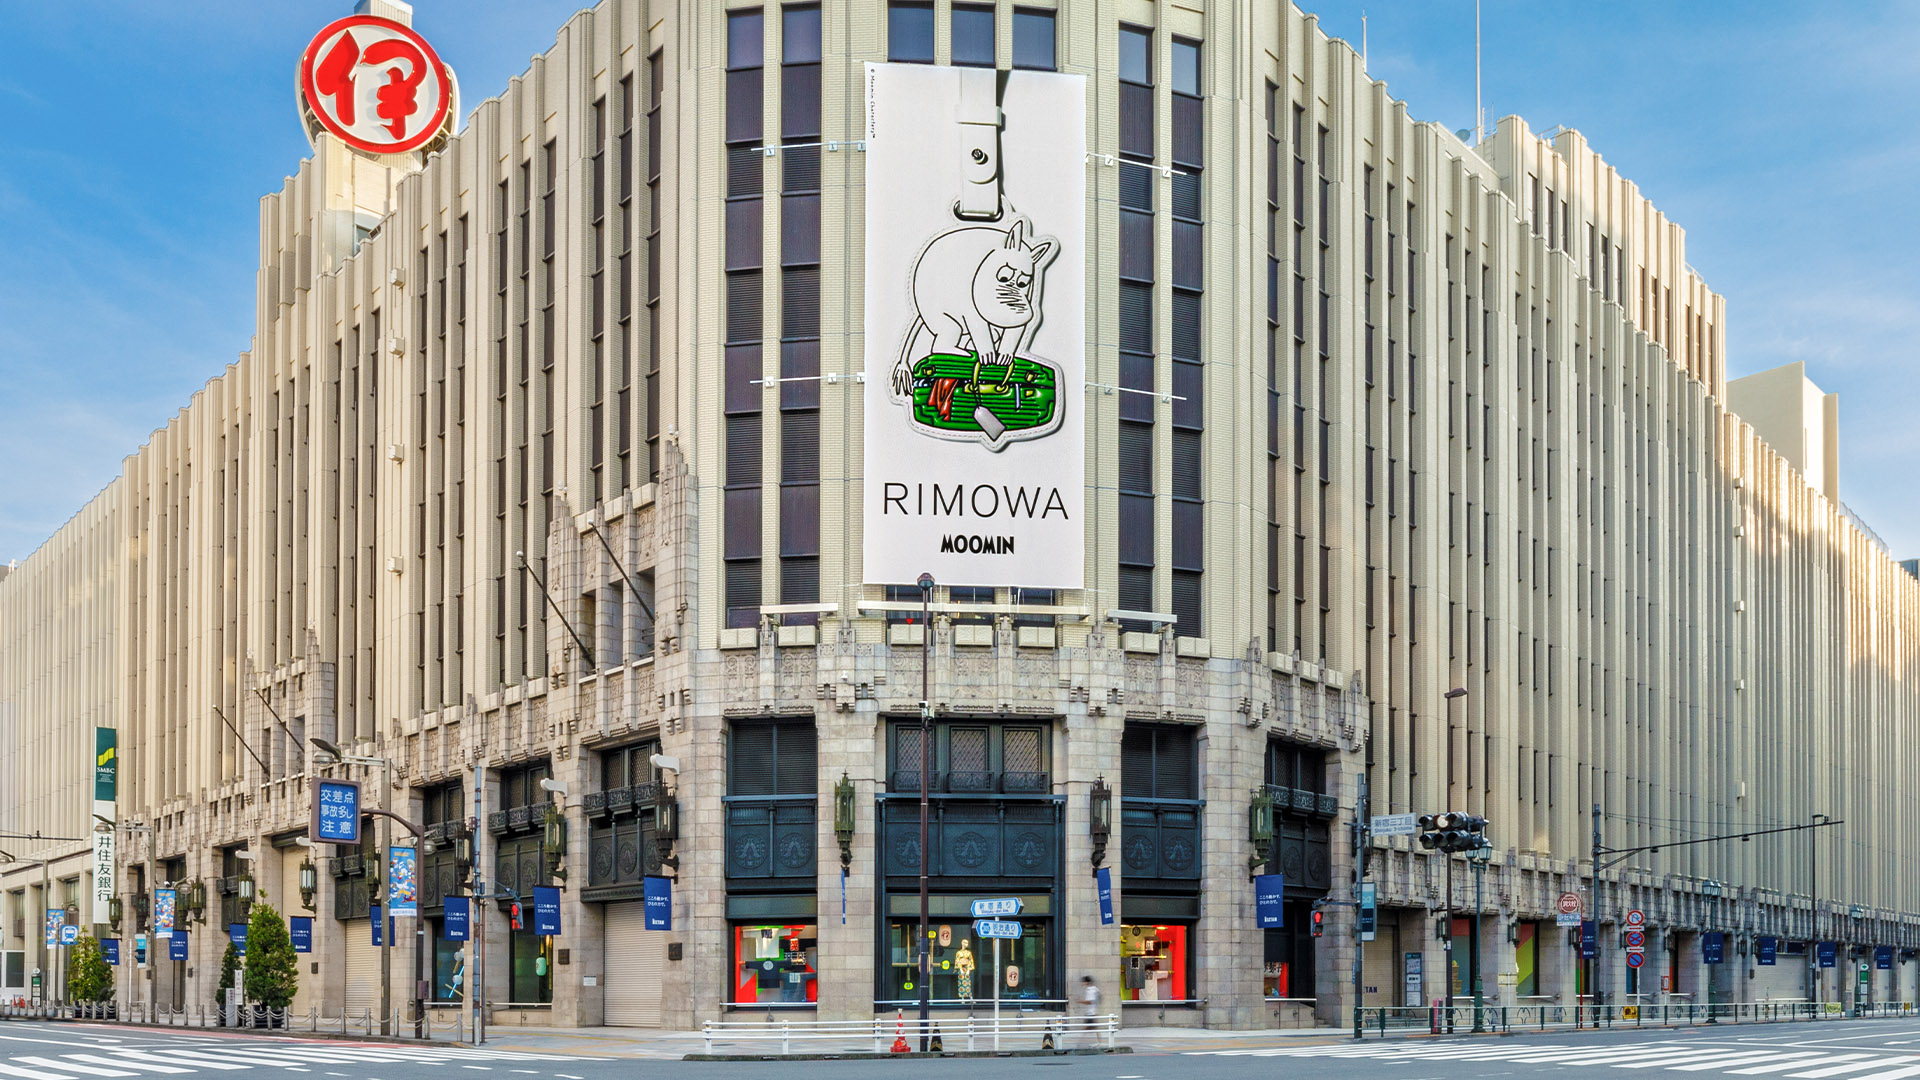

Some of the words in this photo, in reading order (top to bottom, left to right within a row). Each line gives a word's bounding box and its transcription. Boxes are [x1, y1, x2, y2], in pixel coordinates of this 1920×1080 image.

[884, 482, 1069, 520] RIMOWA
[940, 534, 1015, 554] MOOMIN
[321, 789, 354, 804] 交差点
[321, 804, 353, 819] 事故多し
[1374, 816, 1412, 827] 新宿三丁目
[97, 831, 112, 902] 井住友銀行
